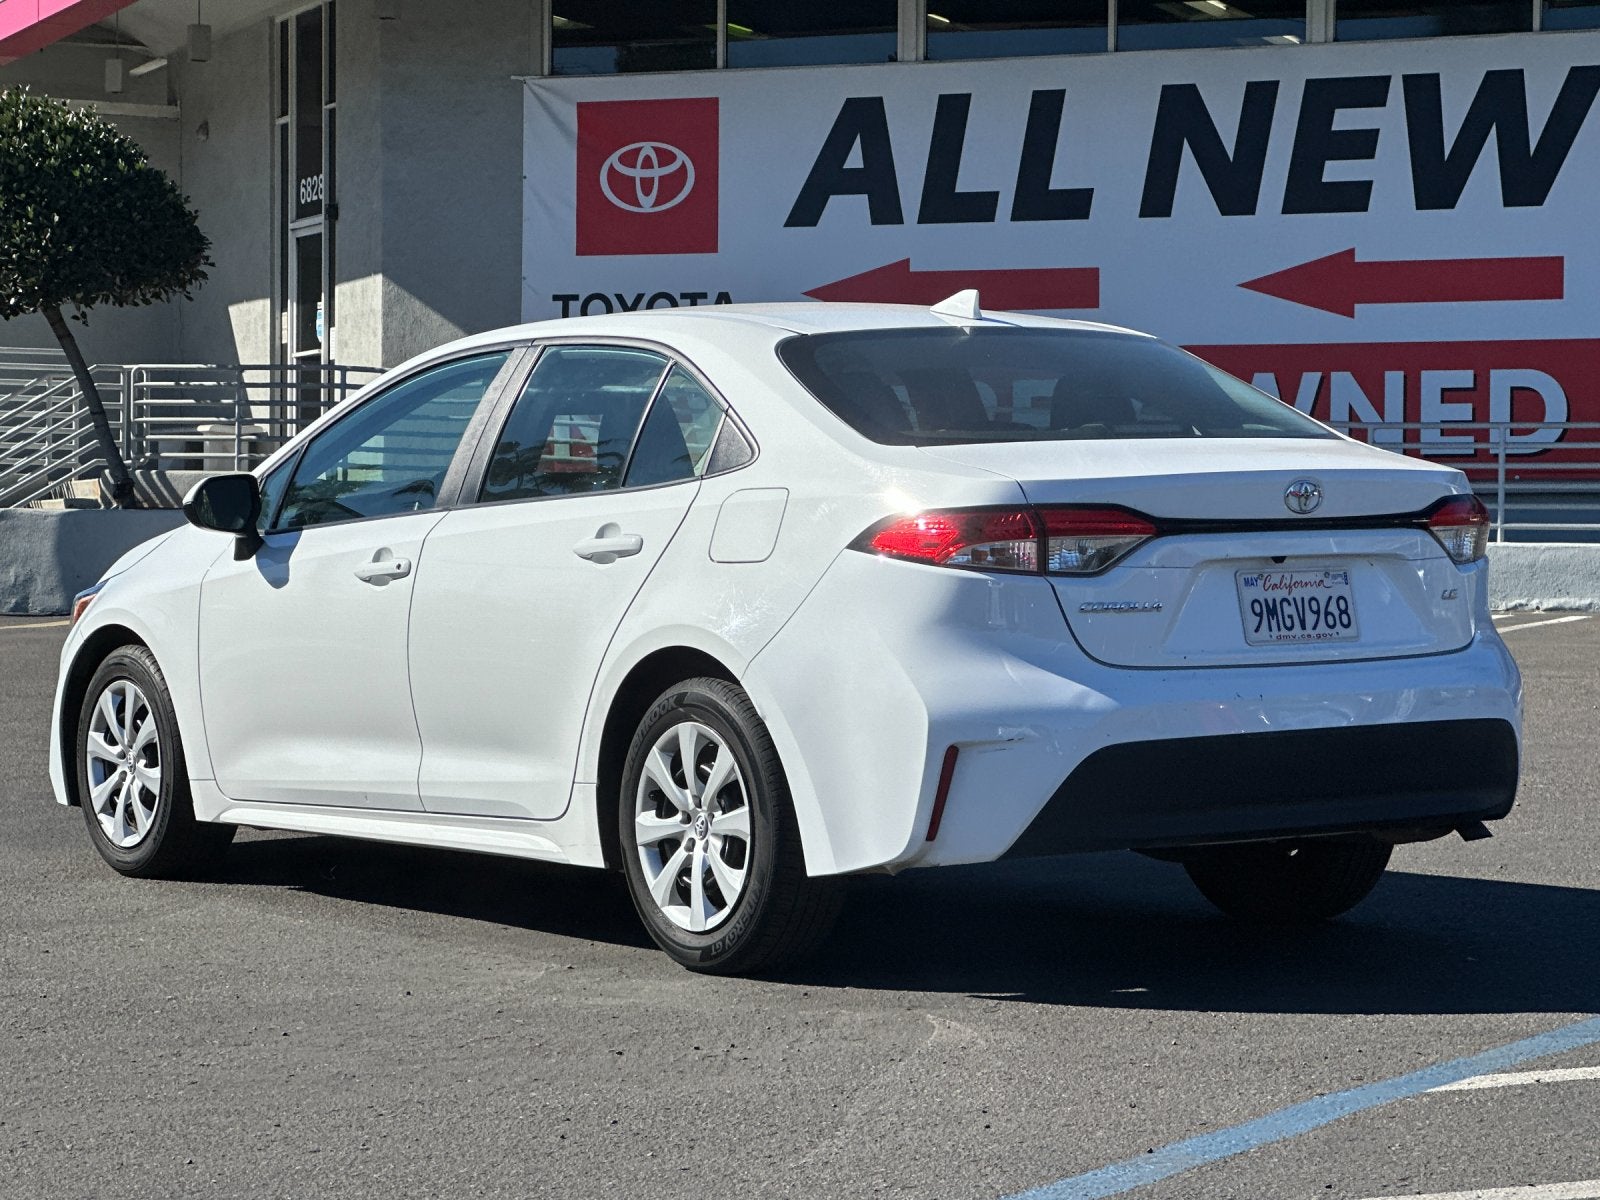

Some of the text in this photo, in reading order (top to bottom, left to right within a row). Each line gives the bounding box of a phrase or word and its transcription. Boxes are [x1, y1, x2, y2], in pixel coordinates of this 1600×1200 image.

[785, 65, 1600, 227] ALL NEW
[300, 173, 324, 204] 6828
[1243, 577, 1259, 588] MAY
[1263, 574, 1332, 596] California
[1250, 596, 1352, 633] 9MGV968
[1276, 632, 1334, 641] dmv.ca.gov
